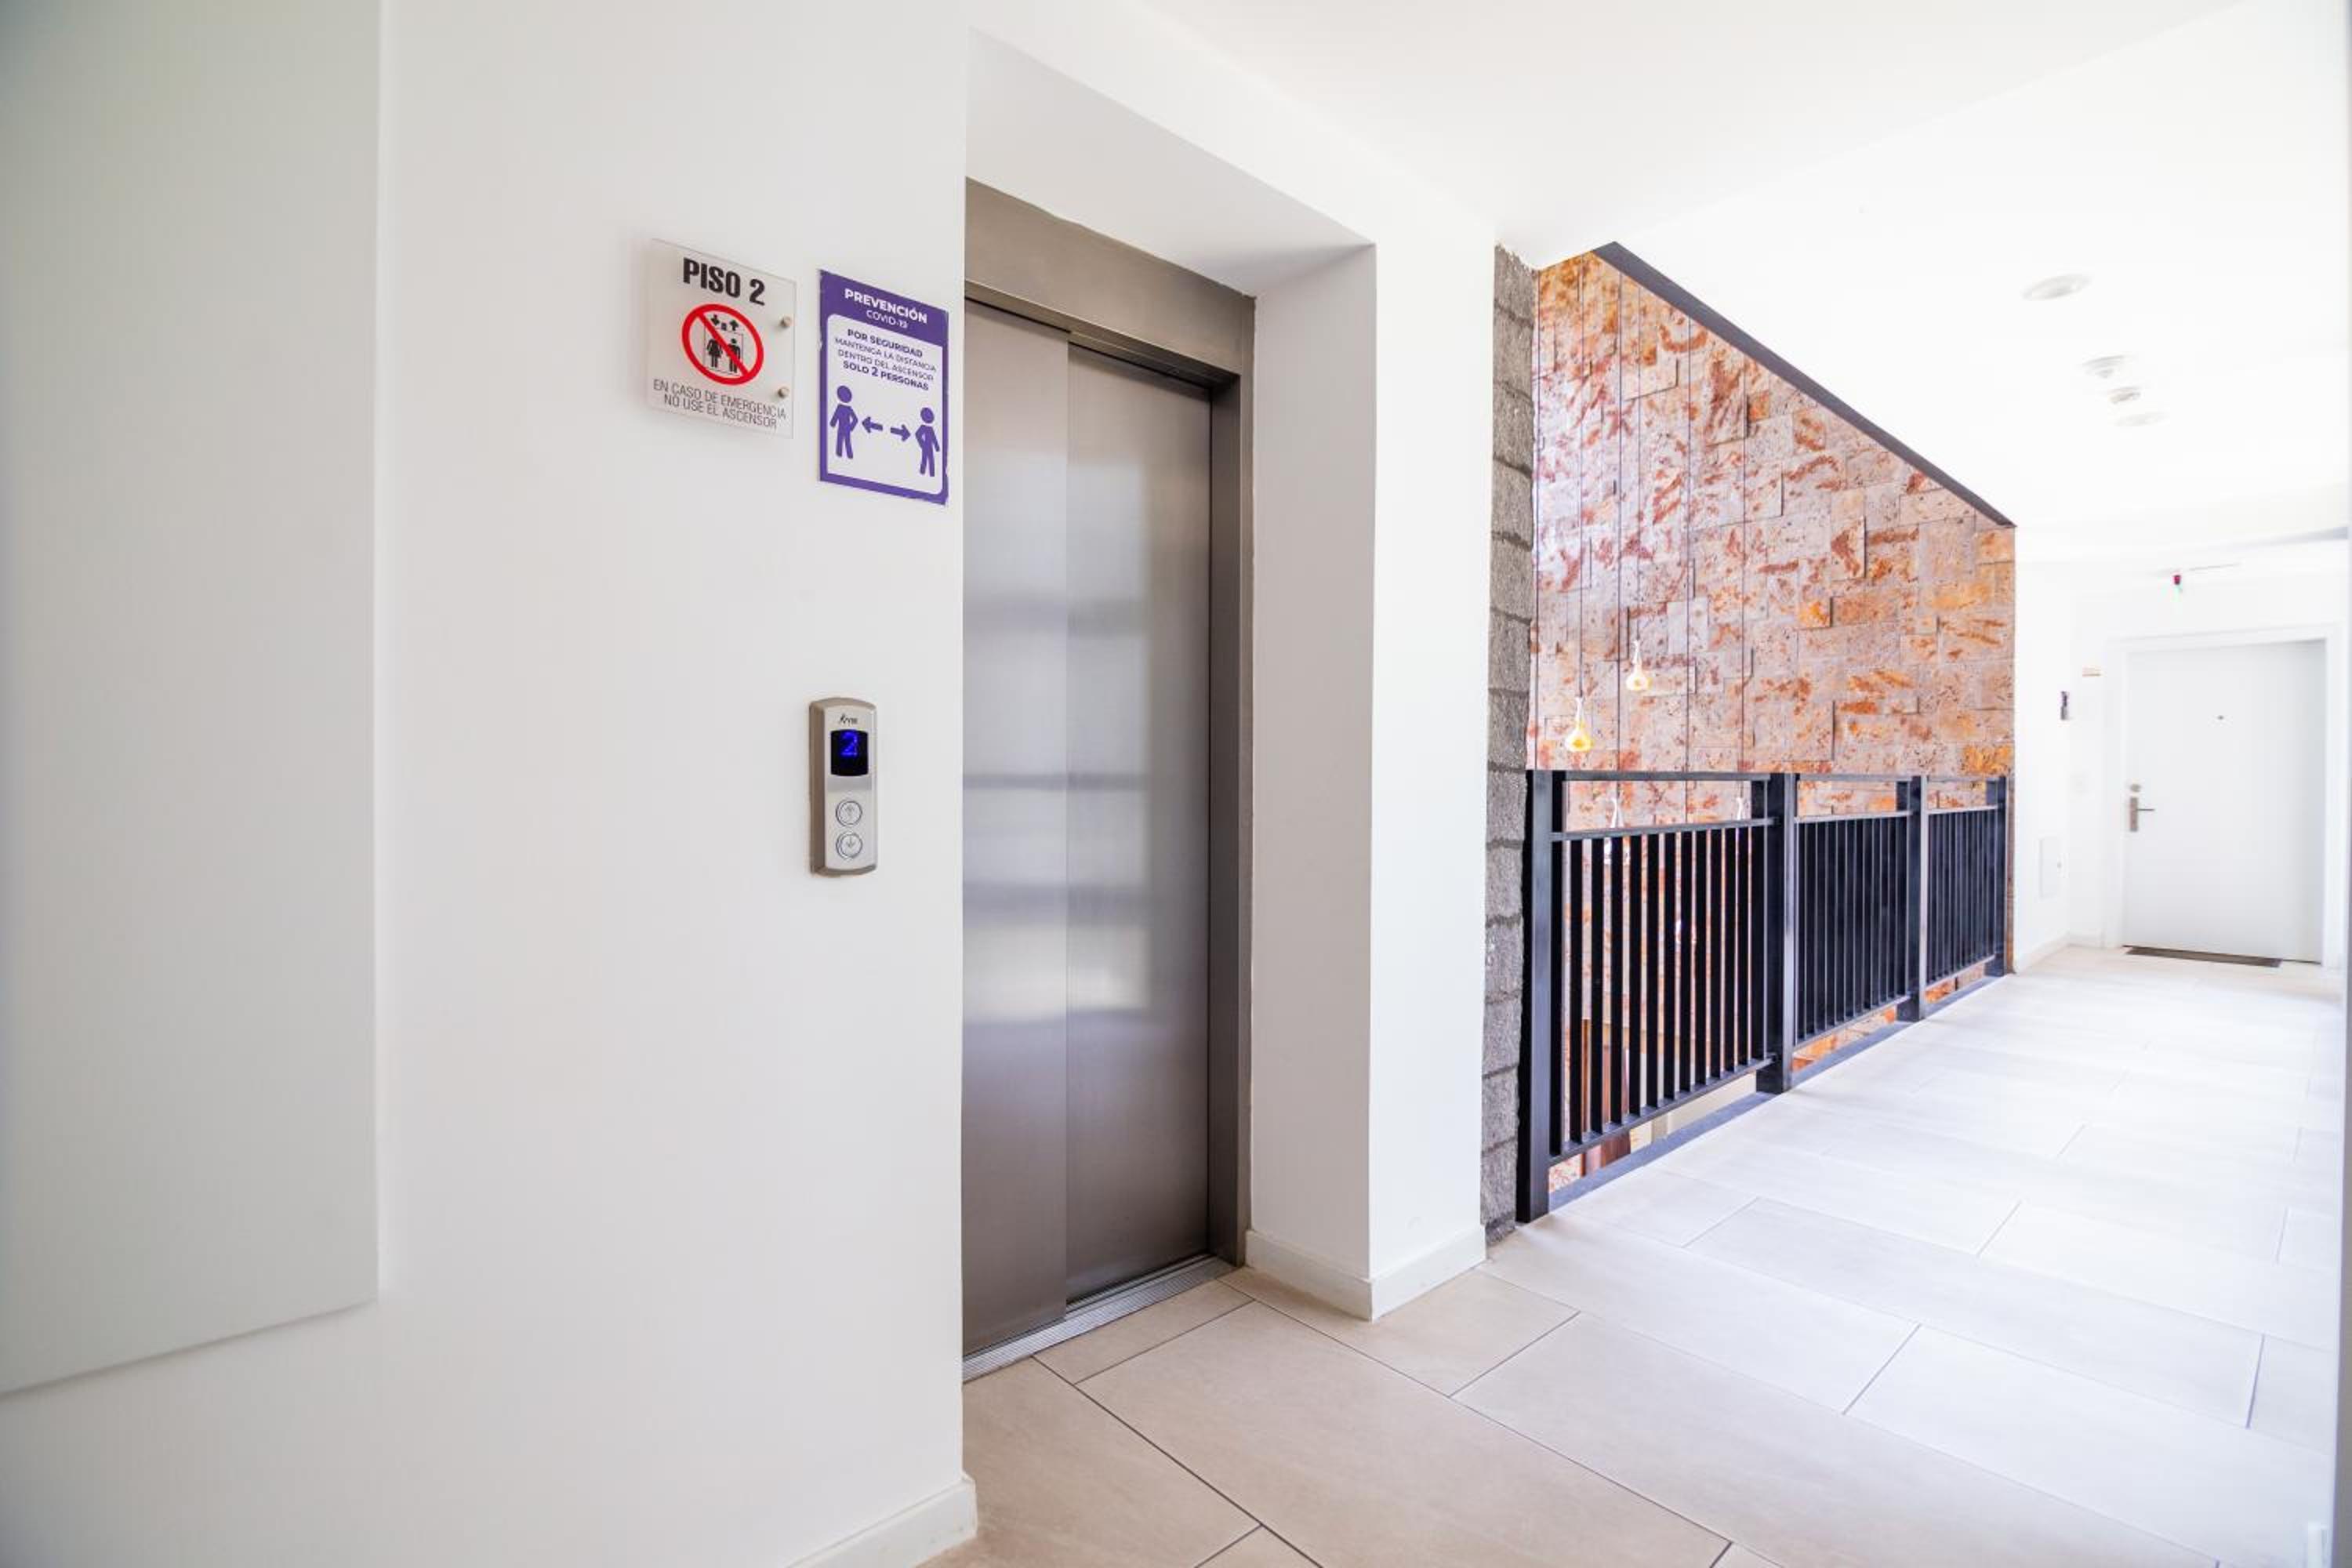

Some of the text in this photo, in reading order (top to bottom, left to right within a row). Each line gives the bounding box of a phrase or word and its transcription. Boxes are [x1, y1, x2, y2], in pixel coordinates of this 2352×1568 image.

[683, 256, 765, 307] PISO 2
[844, 288, 927, 324] PREVENCIÓN
[866, 310, 909, 328] COVID-19
[847, 328, 923, 358] POR SEGURIDAD
[838, 349, 934, 381] DENTRO DEL ASCENSOR
[843, 360, 929, 390] SOLO 2 PERSONAS
[884, 351, 894, 360] LA
[896, 354, 937, 372] DISTANCIA
[653, 379, 786, 419] EN CASO DE EMERGENCIA
[664, 394, 777, 430] NO USE EL ASCENSOR
[841, 731, 858, 757] 2
